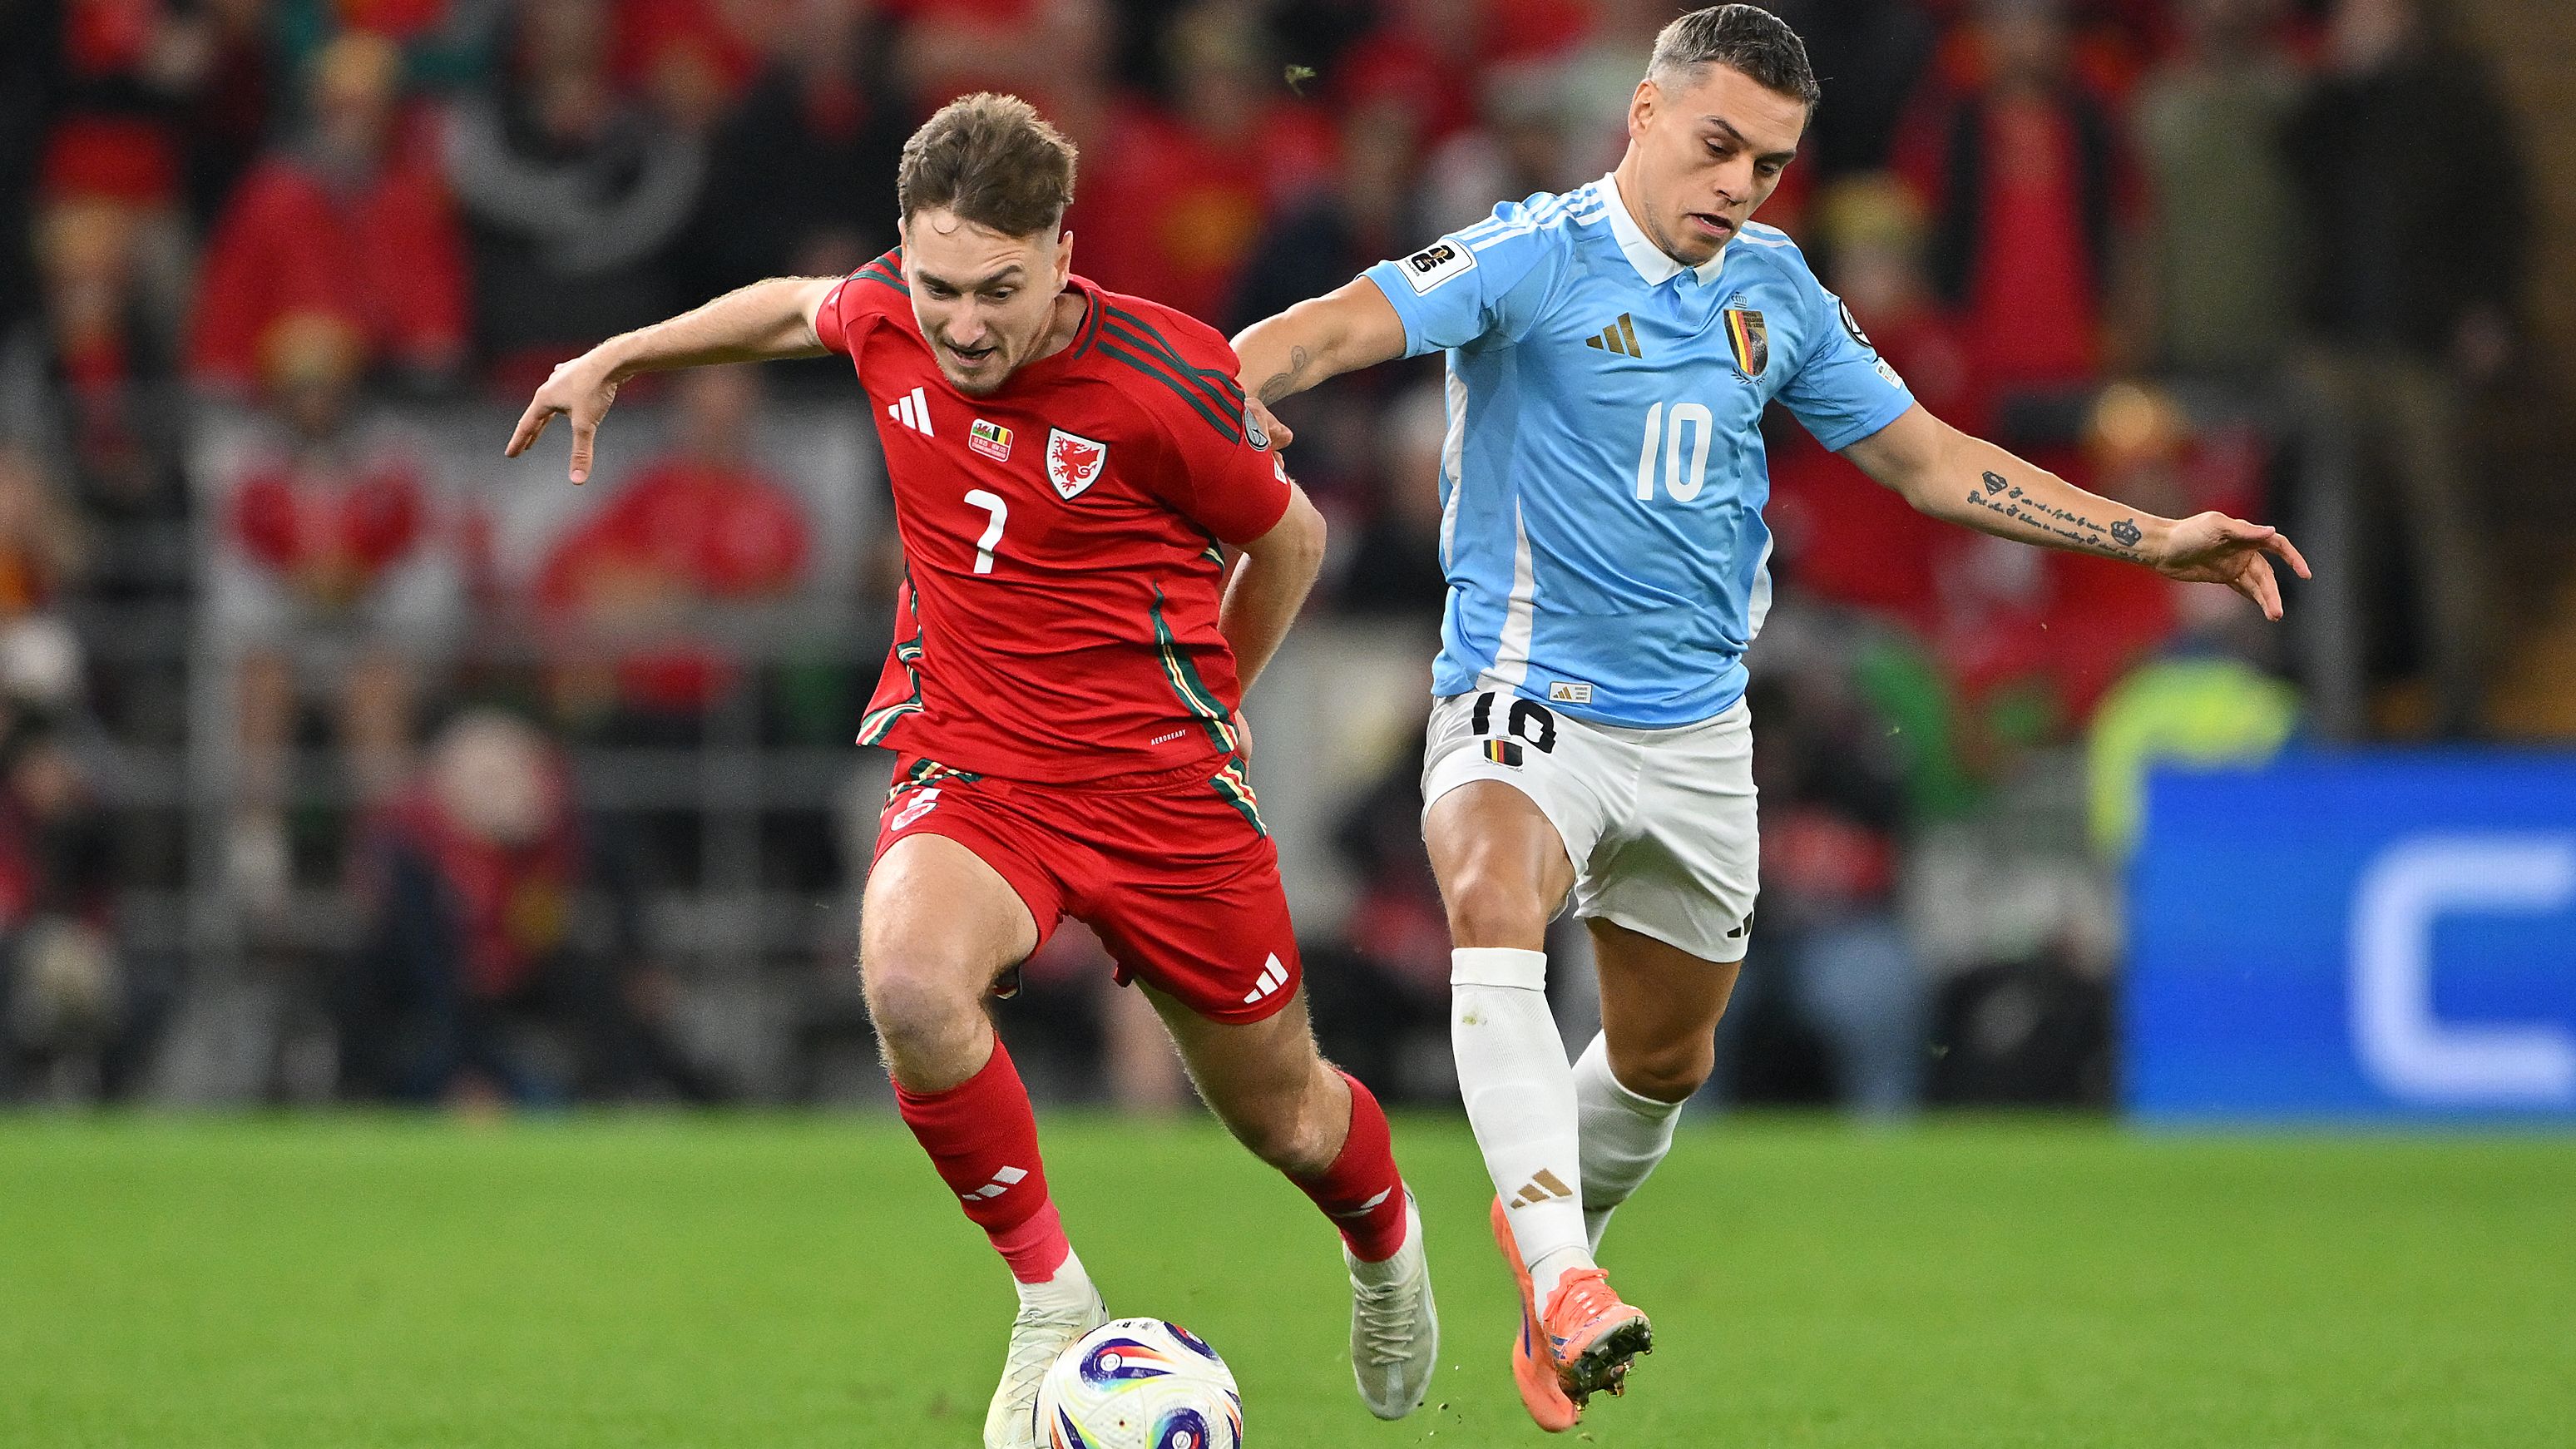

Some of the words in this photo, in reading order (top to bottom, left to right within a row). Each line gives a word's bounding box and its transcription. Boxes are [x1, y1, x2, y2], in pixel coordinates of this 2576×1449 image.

[1636, 401, 1713, 502] 10
[963, 488, 1008, 574] 7
[1150, 729, 1186, 746] AEROREADY
[1471, 691, 1557, 754] 10
